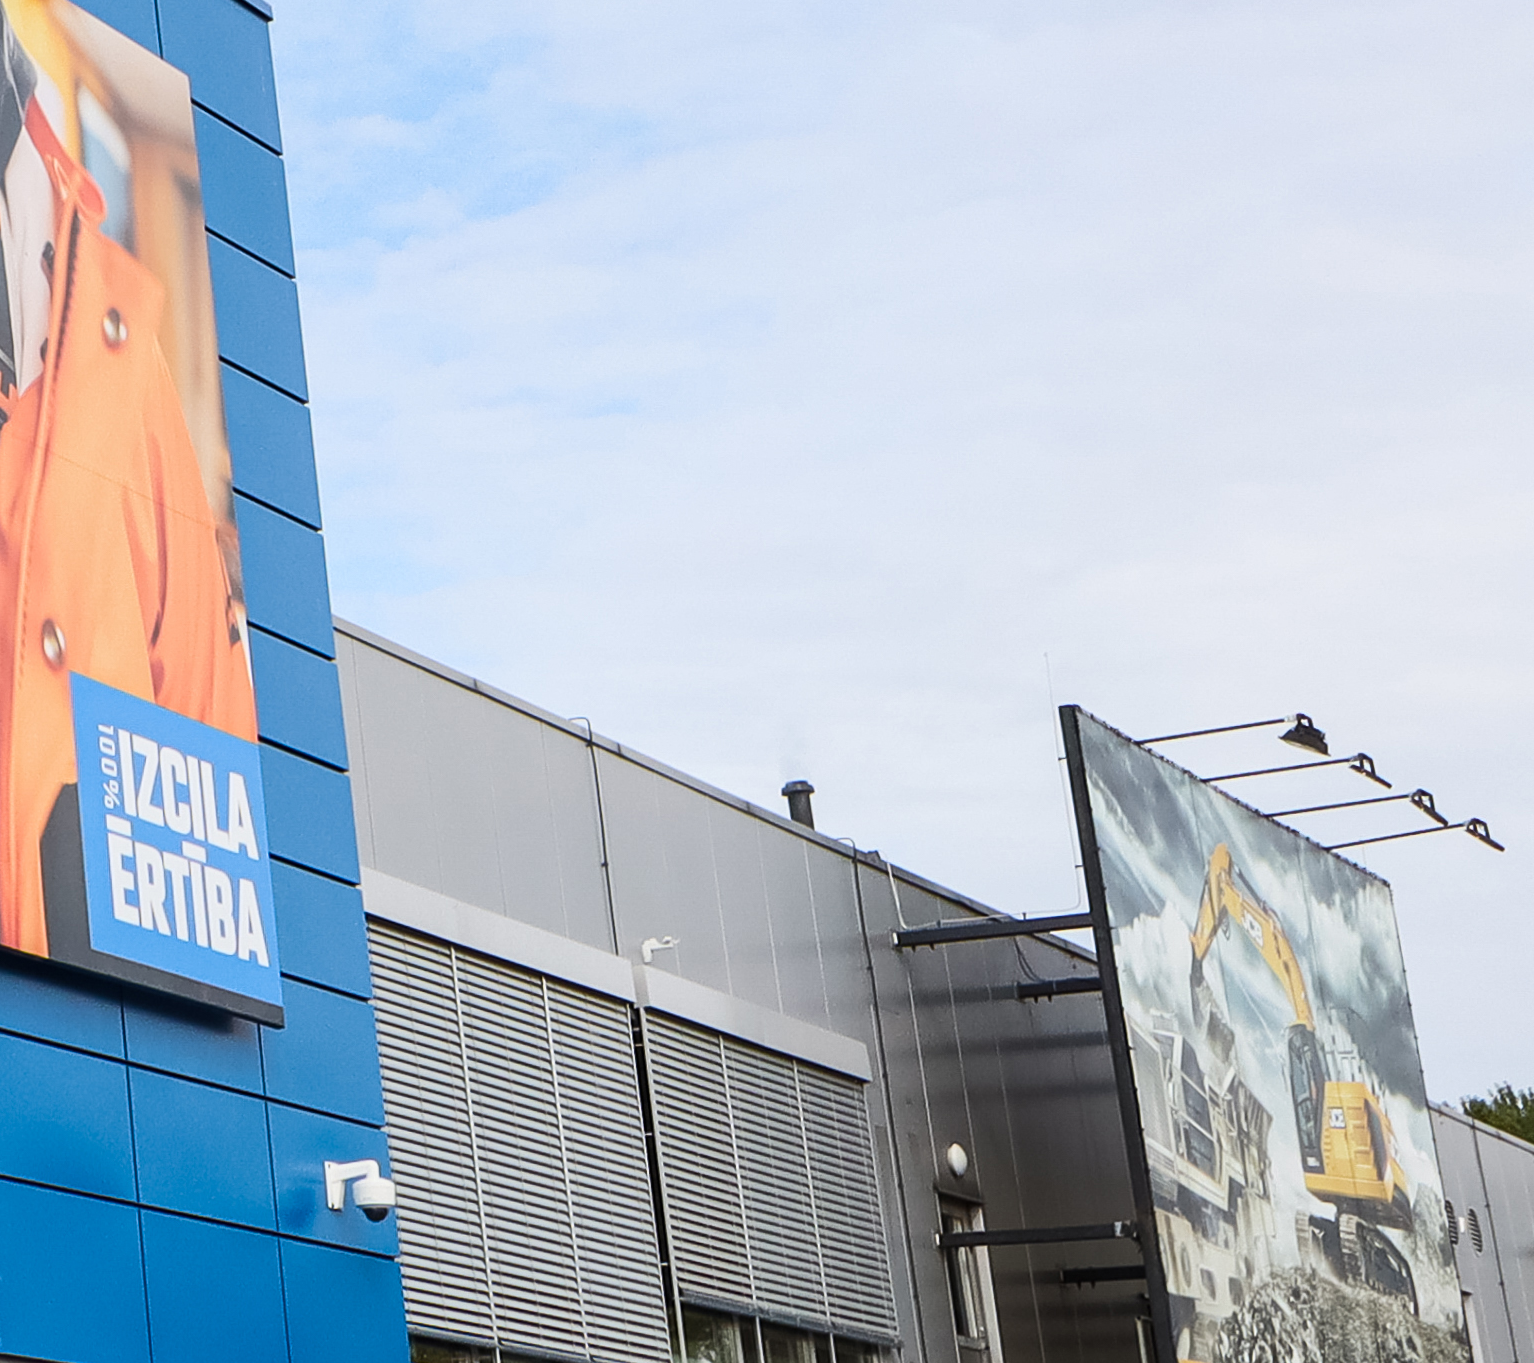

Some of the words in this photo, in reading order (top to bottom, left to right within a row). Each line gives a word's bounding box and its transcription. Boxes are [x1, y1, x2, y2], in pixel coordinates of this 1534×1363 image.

[97, 723, 121, 810] 100%
[117, 728, 260, 861] IZCILA
[105, 813, 270, 968] ĒRTĪBA
